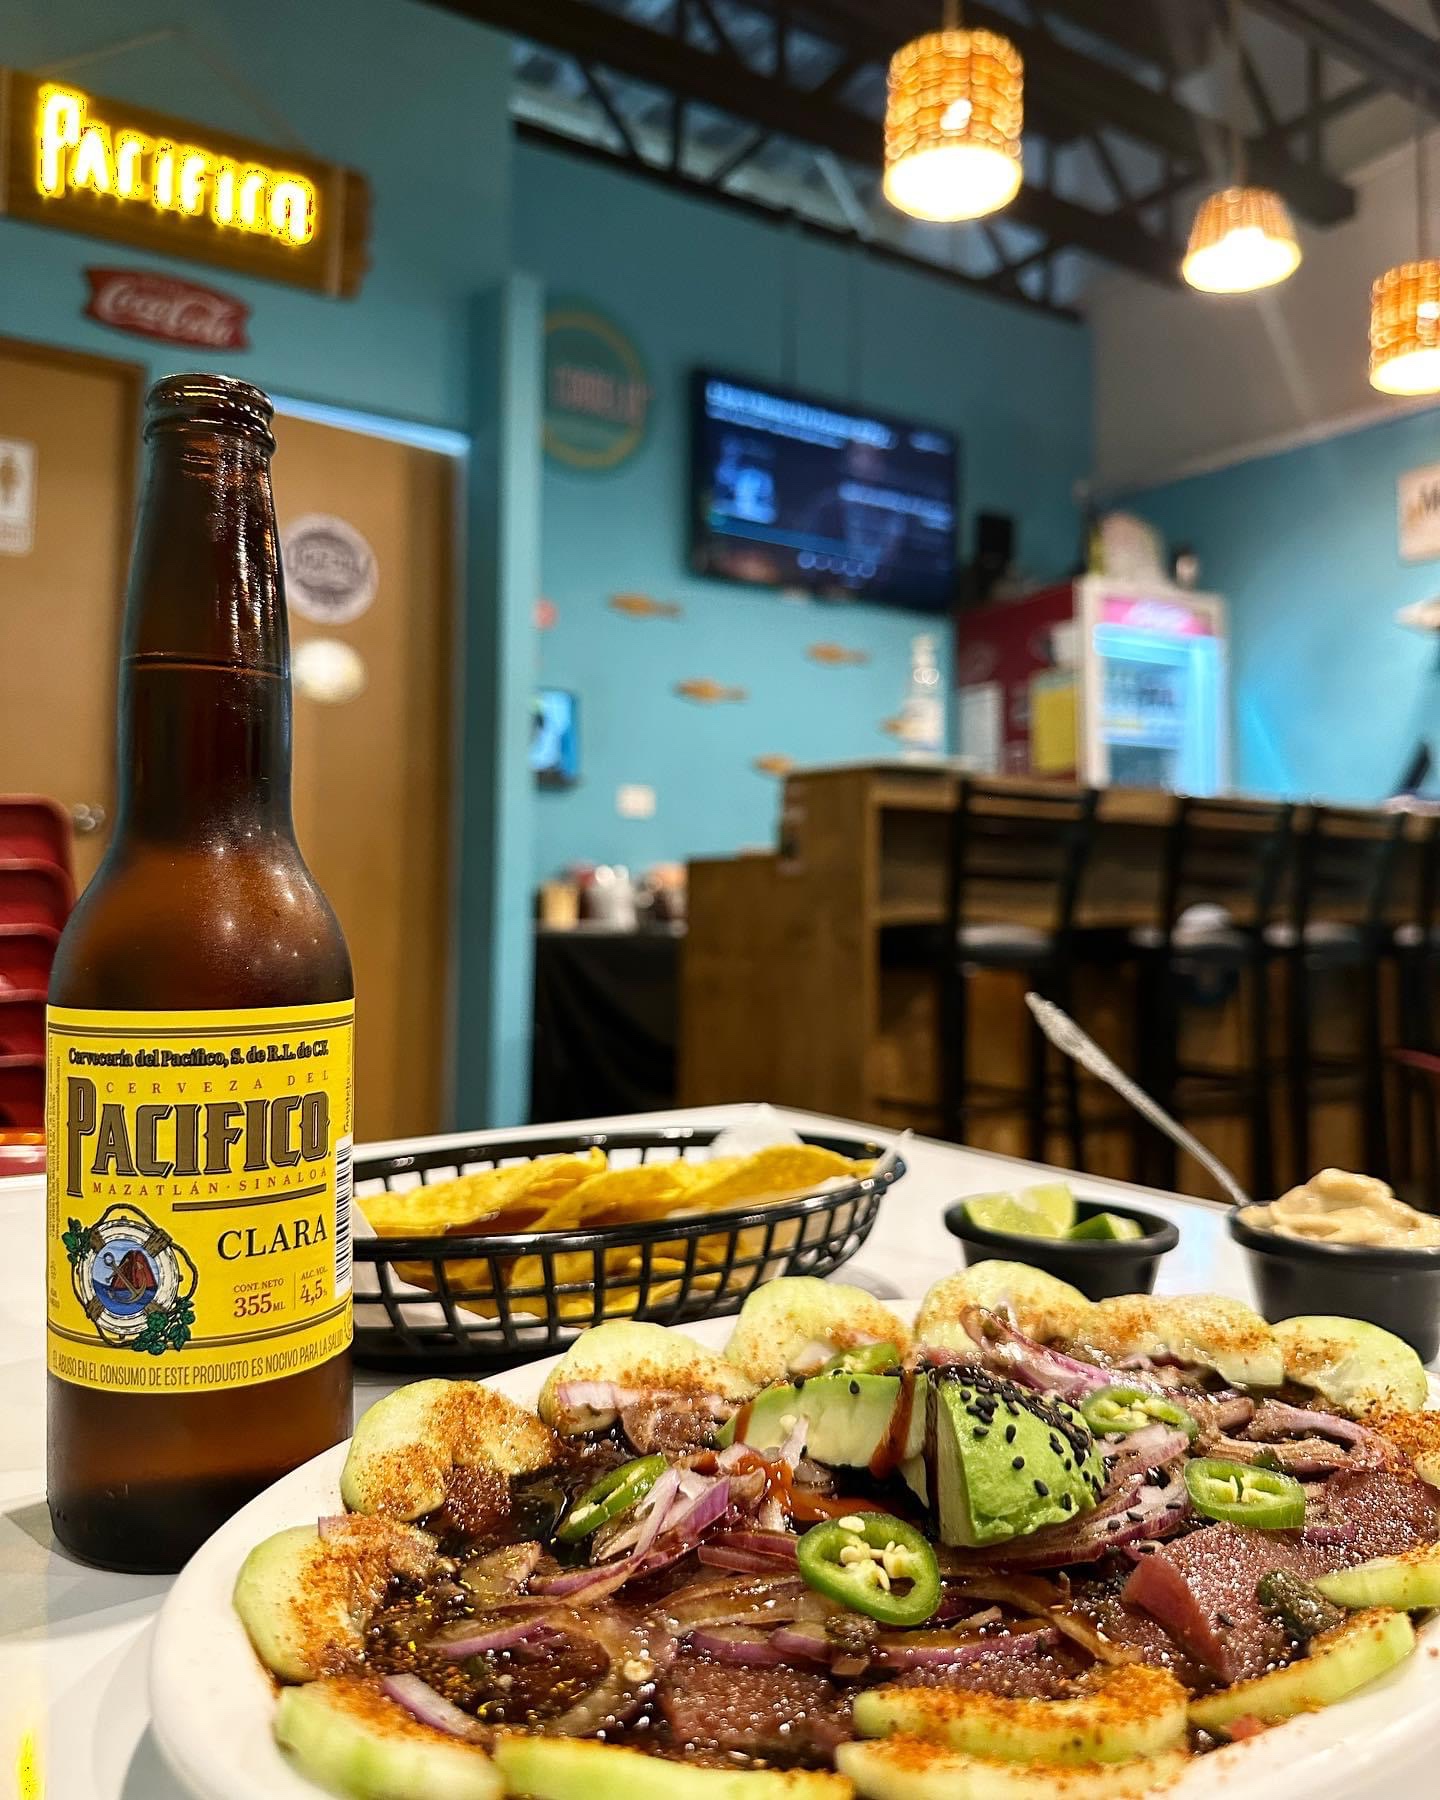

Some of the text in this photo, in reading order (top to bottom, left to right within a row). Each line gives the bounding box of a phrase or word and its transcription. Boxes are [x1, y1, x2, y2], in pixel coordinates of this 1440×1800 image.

[68, 1047, 133, 1067] Cervecería
[135, 1048, 159, 1067] del
[230, 1047, 245, 1065] S.
[246, 1045, 266, 1064] de
[267, 1043, 296, 1063] R.L.
[297, 1041, 312, 1060] de
[106, 1070, 328, 1094] CERVEZA DEL
[67, 1076, 330, 1198] PACIFICO
[93, 1167, 327, 1197] MAZATLÁN SINALOA
[217, 1213, 328, 1261] CLARA
[262, 1278, 285, 1290] NETO
[59, 1352, 77, 1377] ABUSO
[78, 1359, 88, 1380] EN
[89, 1362, 99, 1382] EL
[100, 1363, 147, 1386] CONSUMO
[149, 1366, 162, 1386] DE
[165, 1366, 190, 1386] ESTE
[193, 1359, 249, 1385] PRODUCTO
[252, 1357, 263, 1378] ES
[265, 1349, 299, 1374] NOCIVO
[300, 1342, 319, 1365] PARA
[320, 1338, 328, 1357] LA
